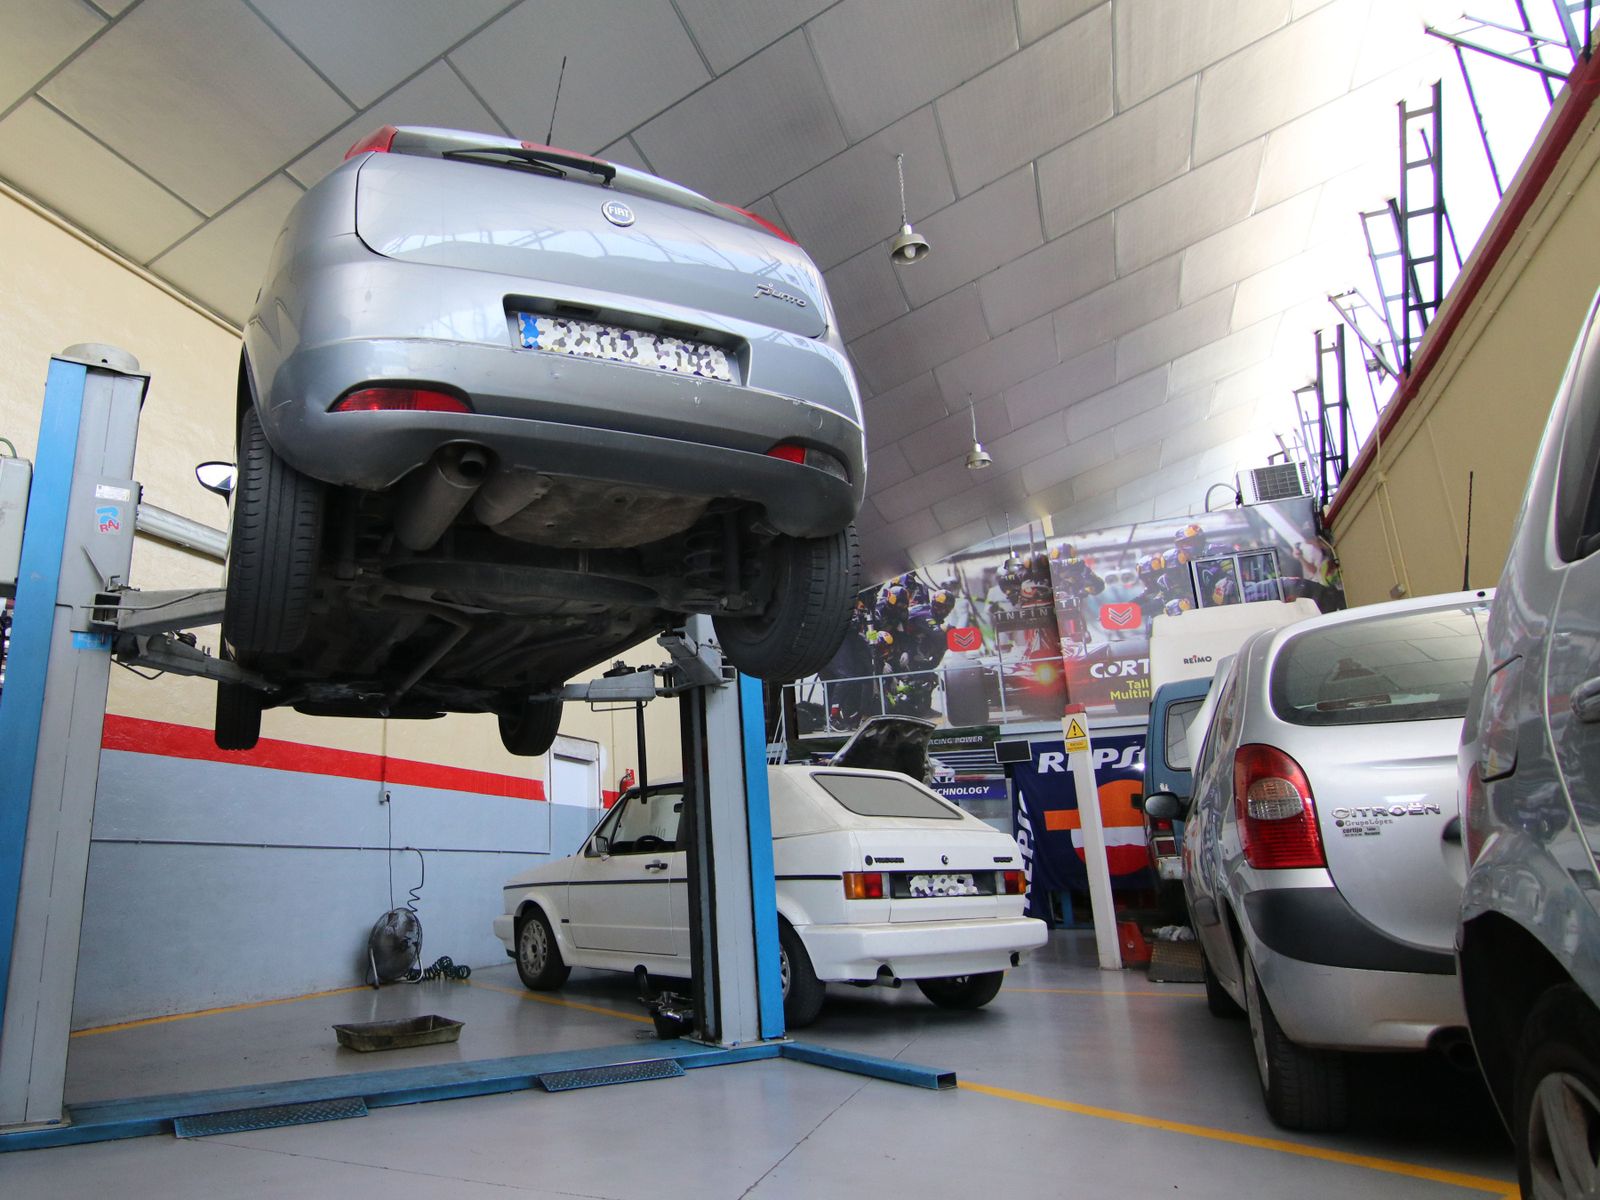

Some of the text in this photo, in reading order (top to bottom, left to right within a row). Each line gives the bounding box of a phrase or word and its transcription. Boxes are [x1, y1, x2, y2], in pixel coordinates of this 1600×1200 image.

[609, 206, 629, 217] FIAT
[754, 282, 806, 307] Punto
[1183, 655, 1212, 664] REIMO
[1126, 678, 1149, 690] Tall
[934, 786, 990, 796] CHNOLOGY
[1331, 803, 1441, 819] CITROËN
